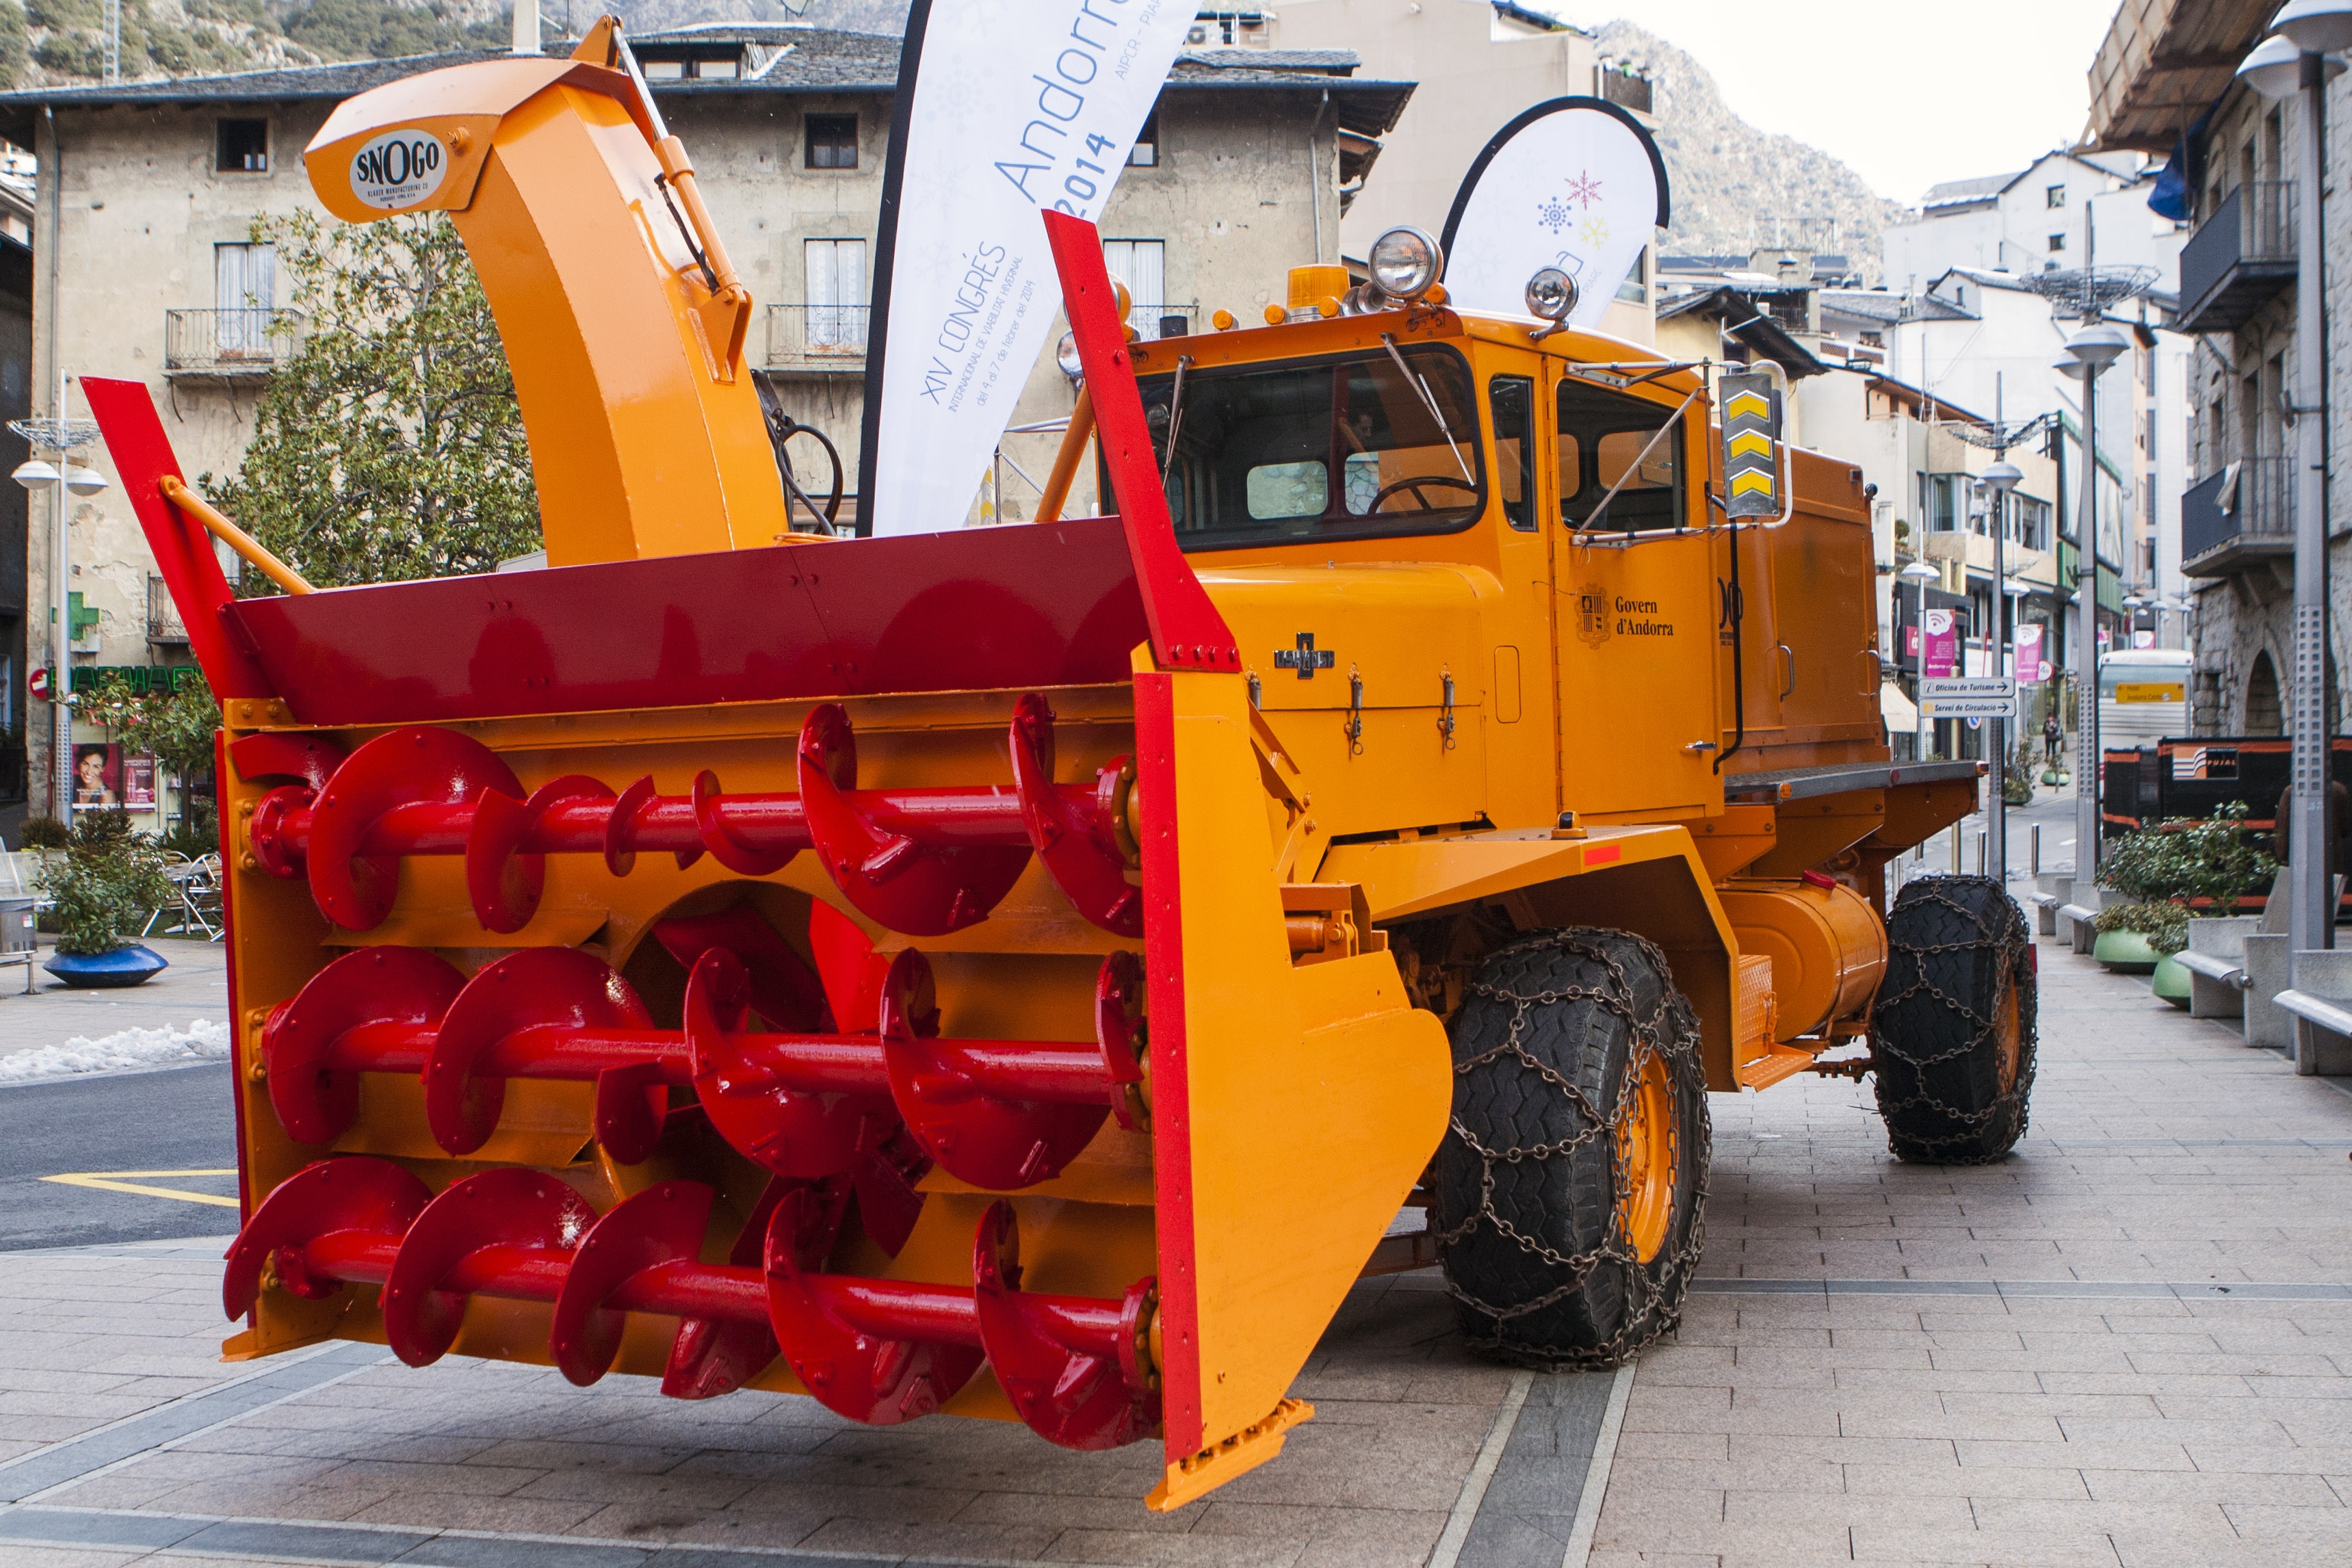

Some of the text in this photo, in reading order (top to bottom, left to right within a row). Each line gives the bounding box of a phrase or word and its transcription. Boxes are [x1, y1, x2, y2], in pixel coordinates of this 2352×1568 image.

[1114, 38, 1142, 81] AIPCR
[1139, 0, 1162, 25] PIA
[994, 0, 1132, 204] Andorr
[356, 140, 440, 185] SNOGO
[1054, 133, 1116, 218] 2014
[385, 183, 421, 194] MANUFACTURING
[1020, 279, 1036, 302] 2014
[1017, 302, 1027, 318] del
[919, 241, 1006, 405] XIV CONGRÉS
[948, 257, 1023, 413] INTERNACIONAL DE VIABILITAT HIVERNAL
[1002, 319, 1020, 348] febrer
[997, 348, 1008, 361] de
[990, 361, 1000, 371] 7
[988, 371, 997, 382] al
[976, 390, 989, 406] del
[1615, 596, 1658, 614] Govern
[1617, 618, 1674, 636] d'Andorra
